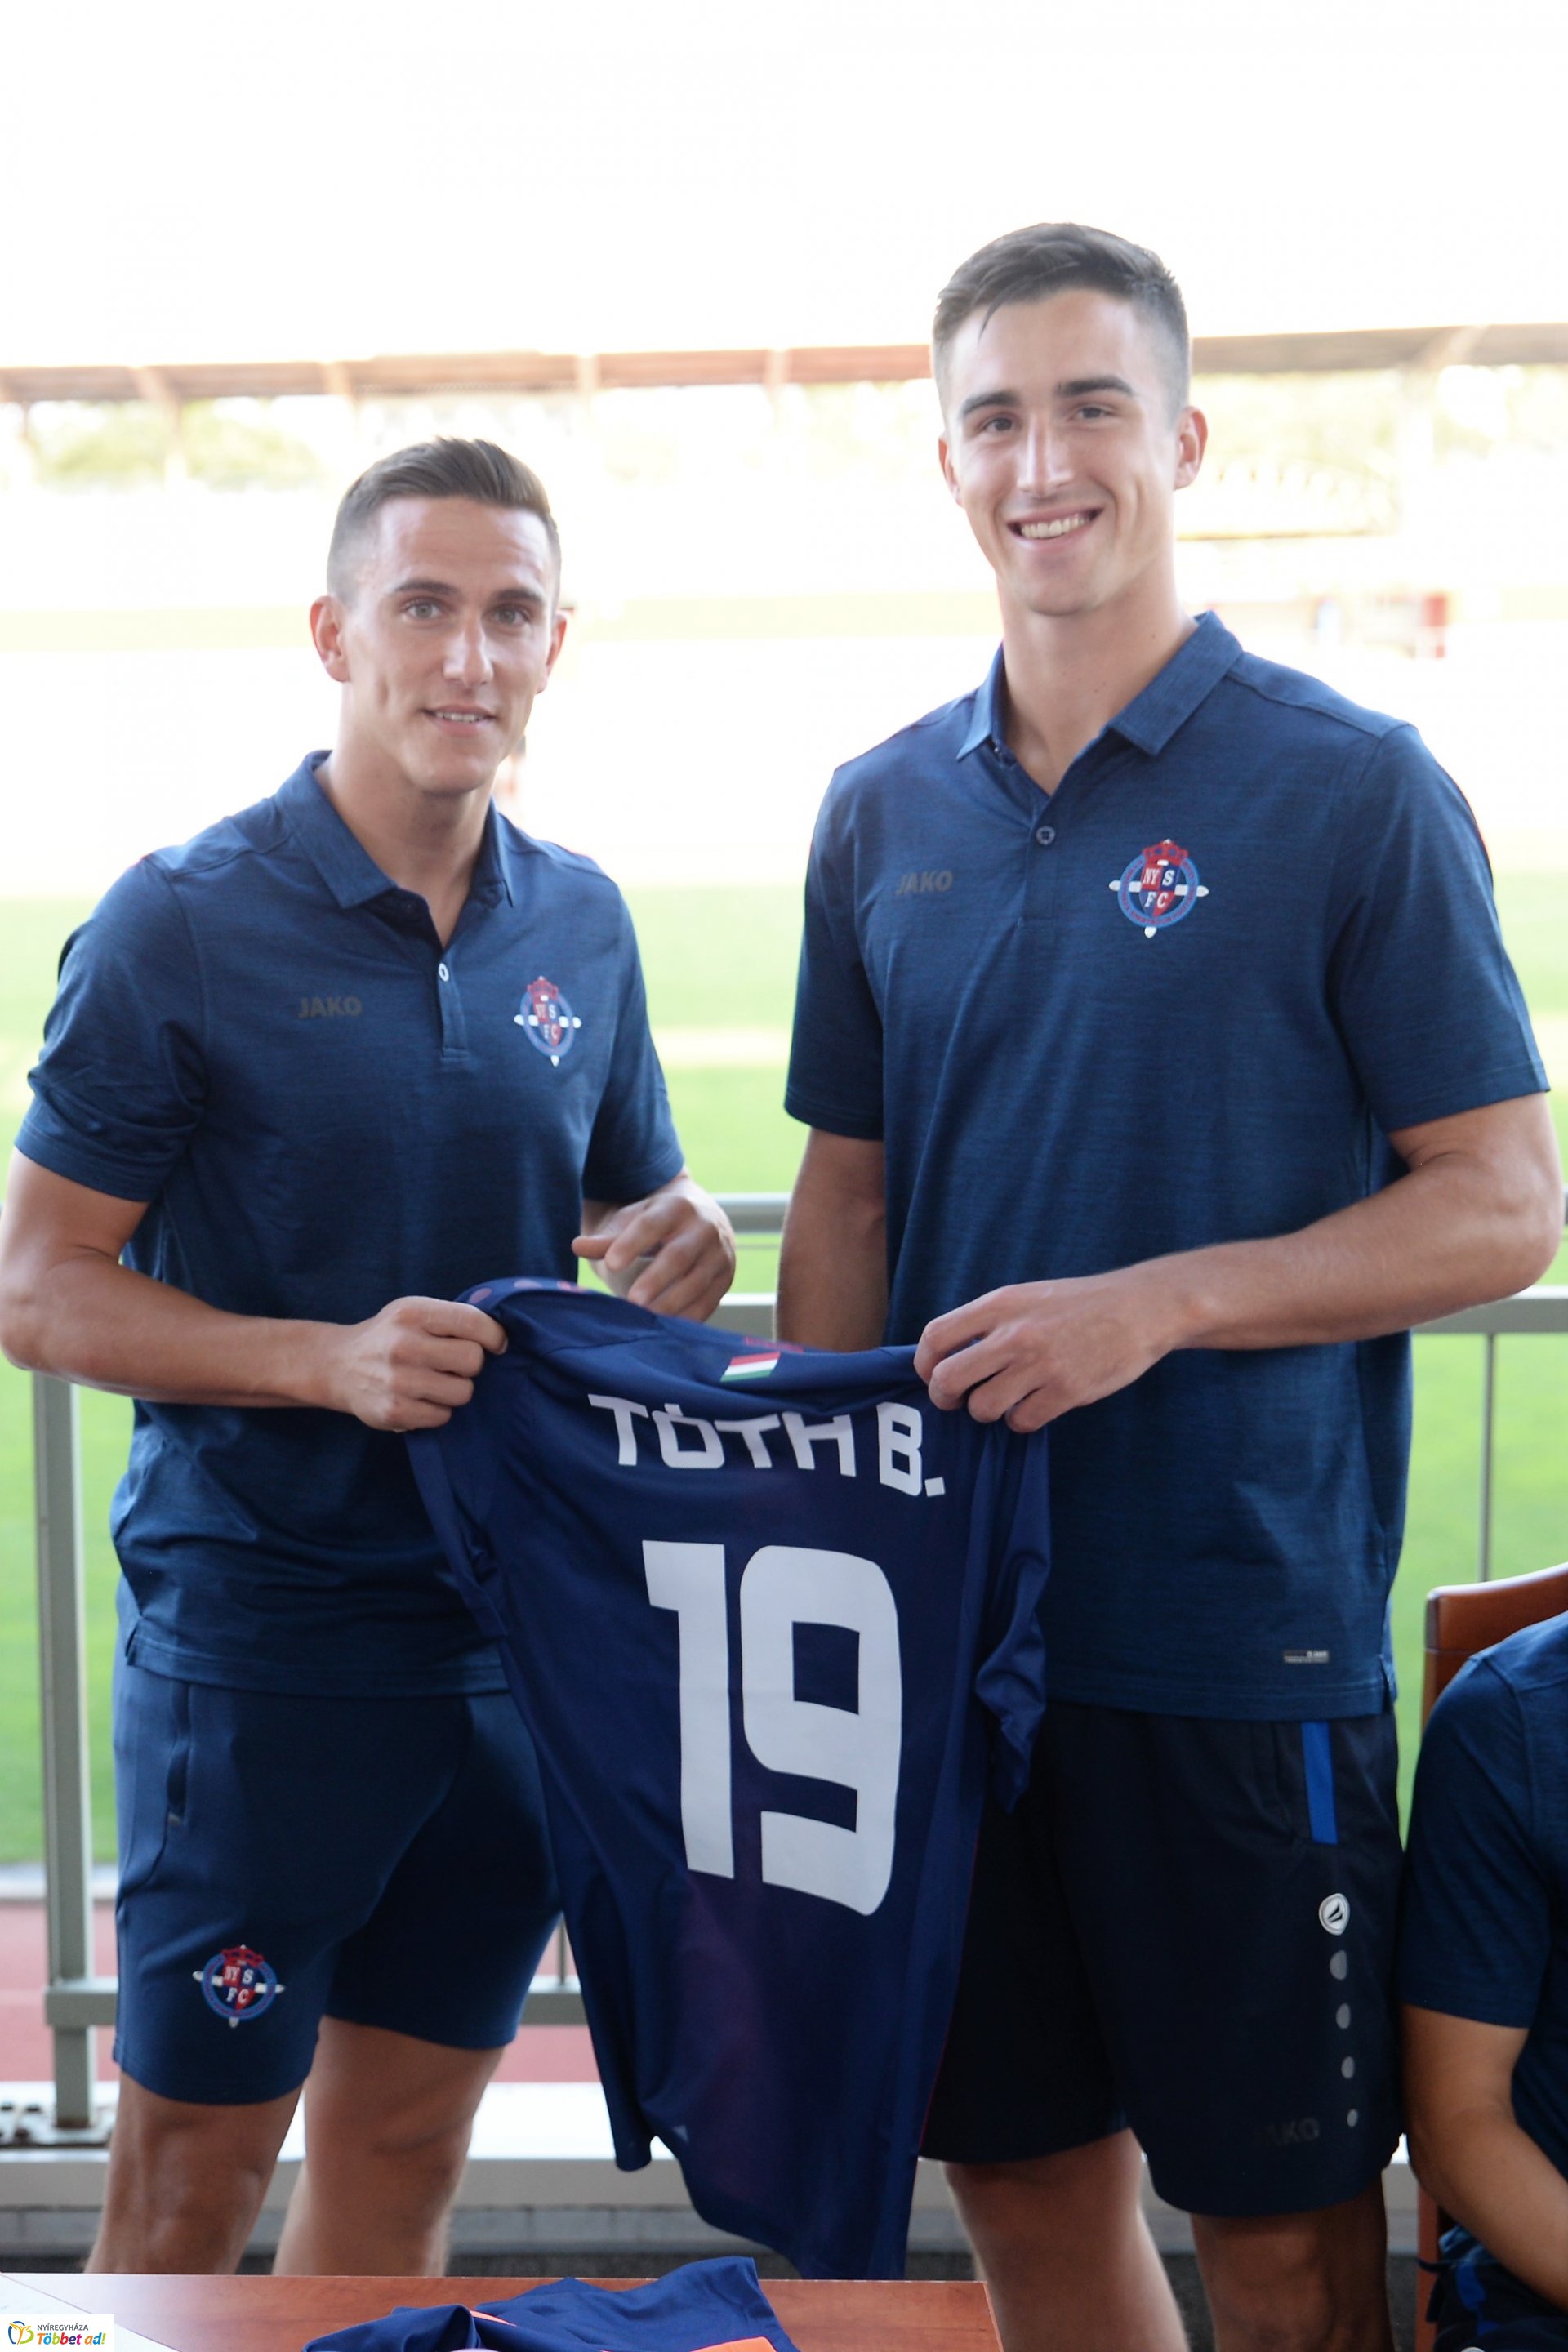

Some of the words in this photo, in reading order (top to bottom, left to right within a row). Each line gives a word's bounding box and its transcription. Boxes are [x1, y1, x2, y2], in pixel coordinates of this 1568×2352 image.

[895, 871, 953, 896] JAKO
[299, 996, 363, 1018] JAKO
[876, 1401, 945, 1497] B.
[642, 1539, 902, 1916] 19
